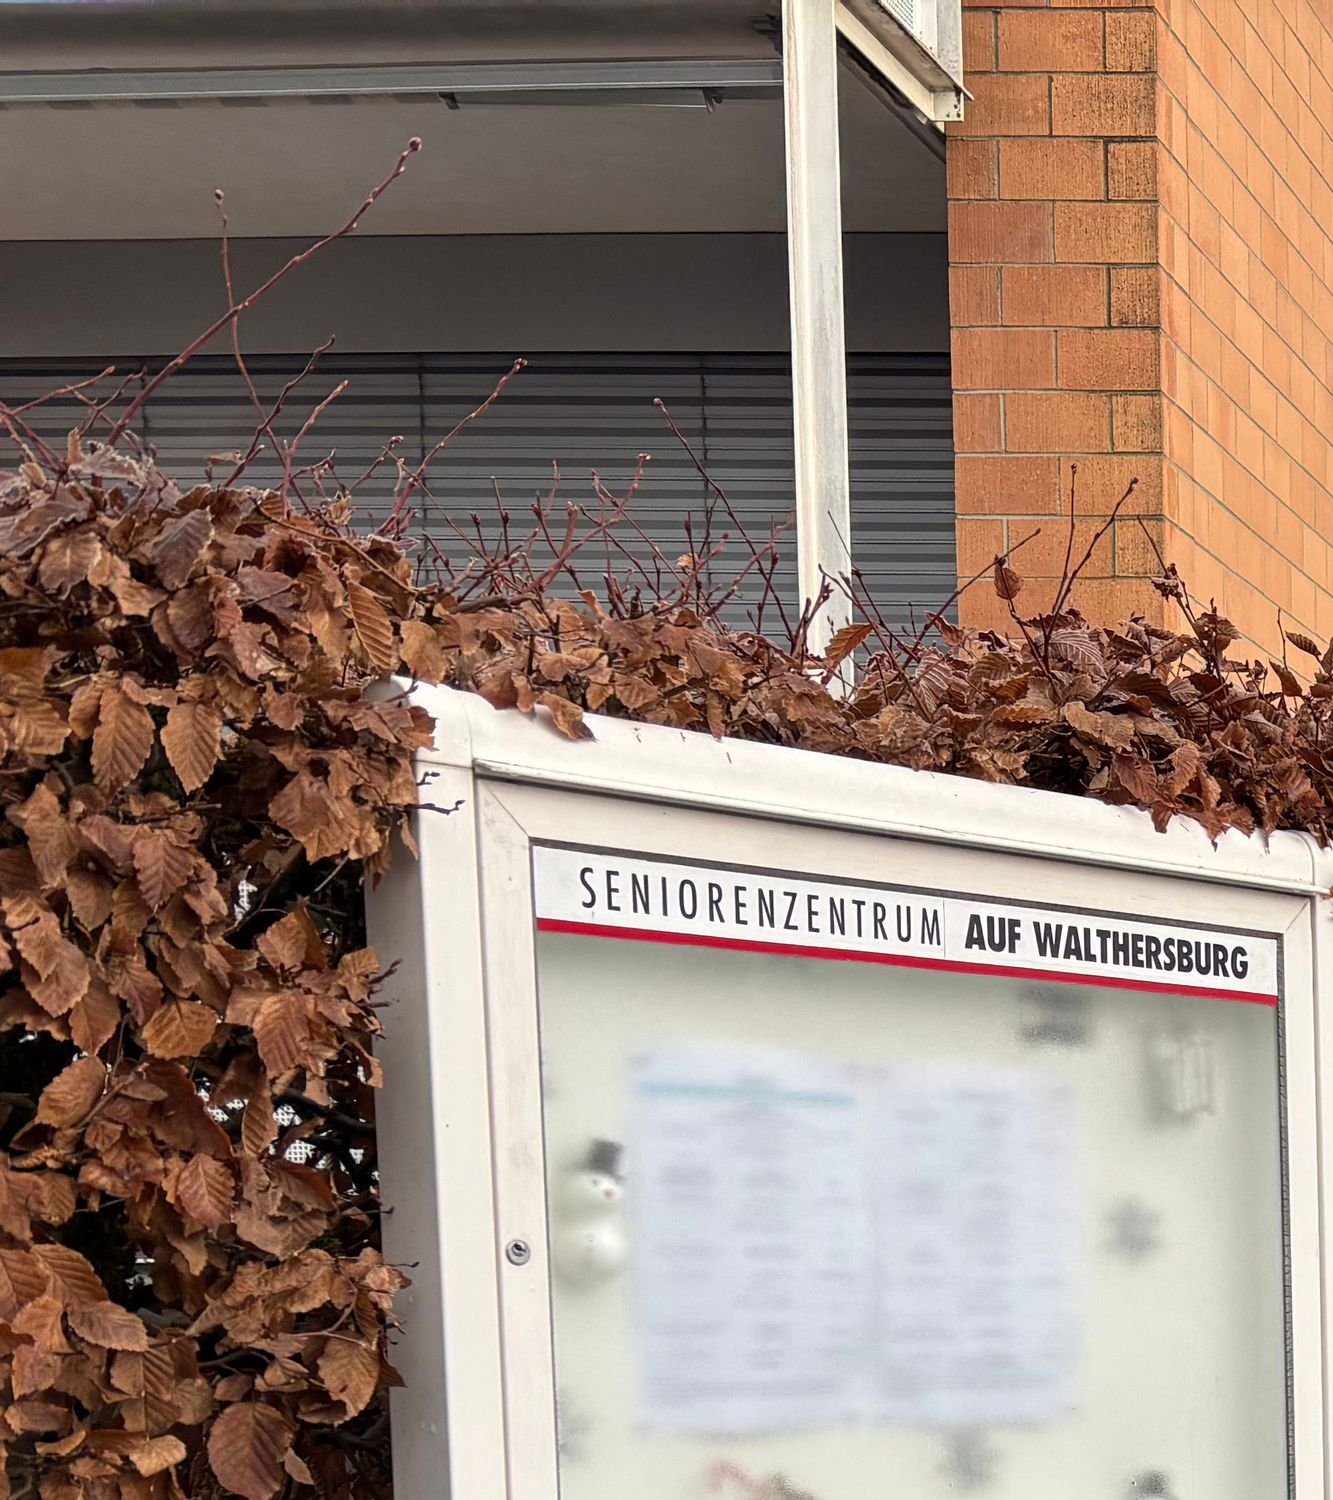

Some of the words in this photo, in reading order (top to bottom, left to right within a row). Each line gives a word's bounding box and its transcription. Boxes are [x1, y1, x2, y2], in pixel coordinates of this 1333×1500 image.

[579, 867, 942, 946] SENIORENZENTRUM
[965, 913, 1021, 954] AUF
[1033, 921, 1249, 980] WALTHERSBURG
